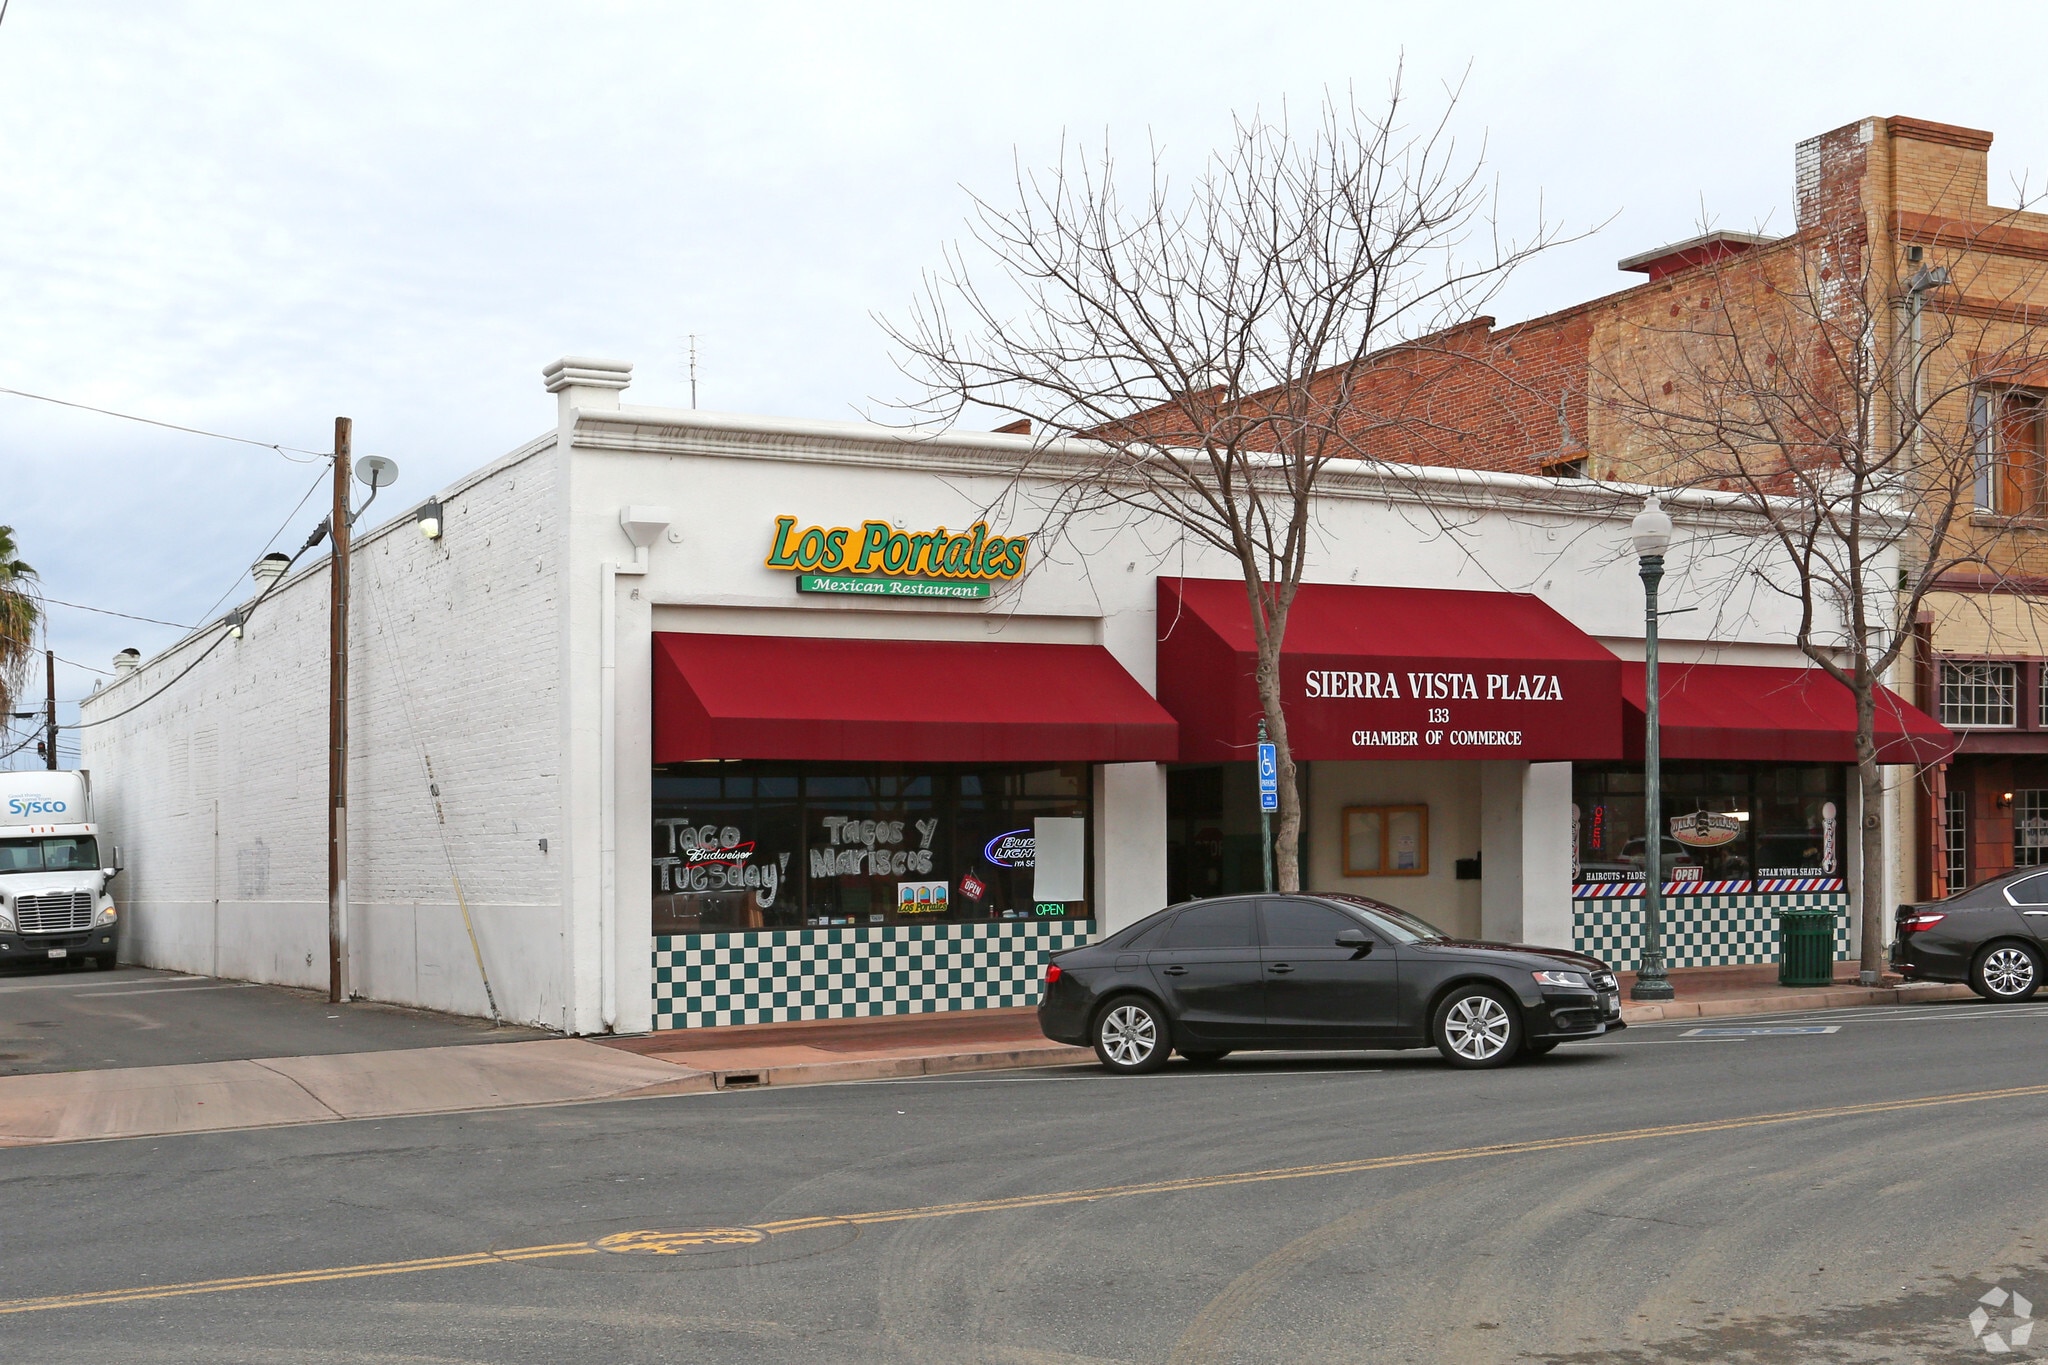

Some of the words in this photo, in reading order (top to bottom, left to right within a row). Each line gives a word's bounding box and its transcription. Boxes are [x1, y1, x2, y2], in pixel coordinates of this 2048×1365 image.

[769, 517, 848, 567] Los
[856, 524, 1026, 576] Portales
[812, 578, 885, 593] Mexican
[889, 581, 980, 598] Restaurant
[1305, 670, 1400, 699] SIERRA
[1407, 672, 1479, 700] VISTA
[1486, 674, 1563, 701] PLAZA
[1428, 708, 1450, 724] 133
[1352, 730, 1418, 746] CHAMBER
[1425, 730, 1443, 745] OF
[1450, 730, 1522, 746] COMMERCE
[9, 799, 67, 817] Sysco
[655, 818, 741, 853] Taco
[1592, 806, 1603, 849] OPEN
[686, 848, 753, 862] Budweiser
[994, 848, 1035, 859] LIGH
[653, 852, 791, 908] Tuesday!
[1586, 872, 1620, 881] HAIRCUTS
[1675, 869, 1700, 881] OPEN
[1758, 868, 1779, 877] STEAM
[1780, 868, 1799, 876] TOWEL
[1800, 867, 1822, 876] SHAVES
[963, 880, 982, 896] OPEN
[898, 902, 914, 913] Los
[915, 902, 947, 912] Portales
[1035, 903, 1064, 916] OPEN
